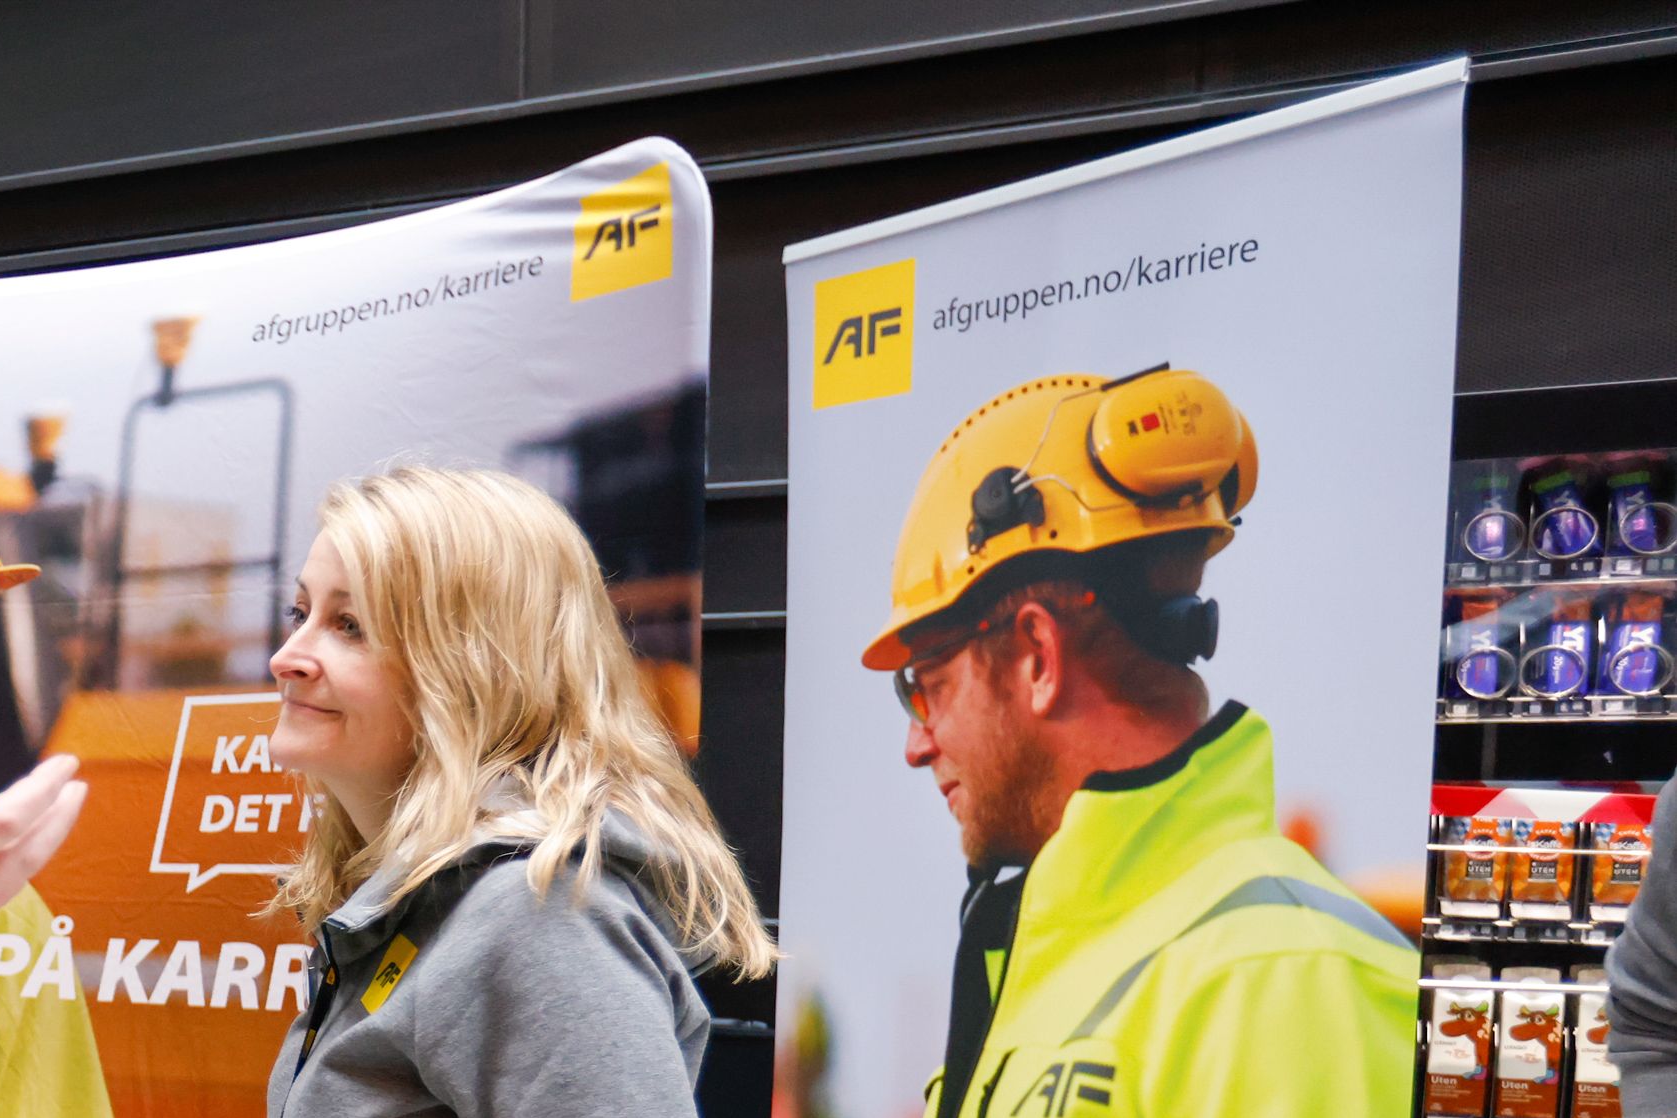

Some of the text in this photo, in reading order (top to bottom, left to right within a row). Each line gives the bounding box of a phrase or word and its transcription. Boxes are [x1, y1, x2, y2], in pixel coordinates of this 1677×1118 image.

[583, 204, 660, 260] AF
[252, 254, 544, 344] afgruppen.no/karriere
[933, 239, 1260, 333] afgruppen.no/karriere
[823, 307, 902, 364] AF
[211, 734, 282, 774] KA
[199, 794, 293, 833] DET
[1468, 865, 1492, 873] UTEN
[1531, 866, 1556, 875] UTEN
[1613, 867, 1640, 876] UTEN
[374, 960, 402, 990] AF
[1010, 1061, 1116, 1118] AF
[1430, 1075, 1458, 1085] Uten
[1501, 1080, 1529, 1090] Uten
[1577, 1083, 1607, 1093] Uten
